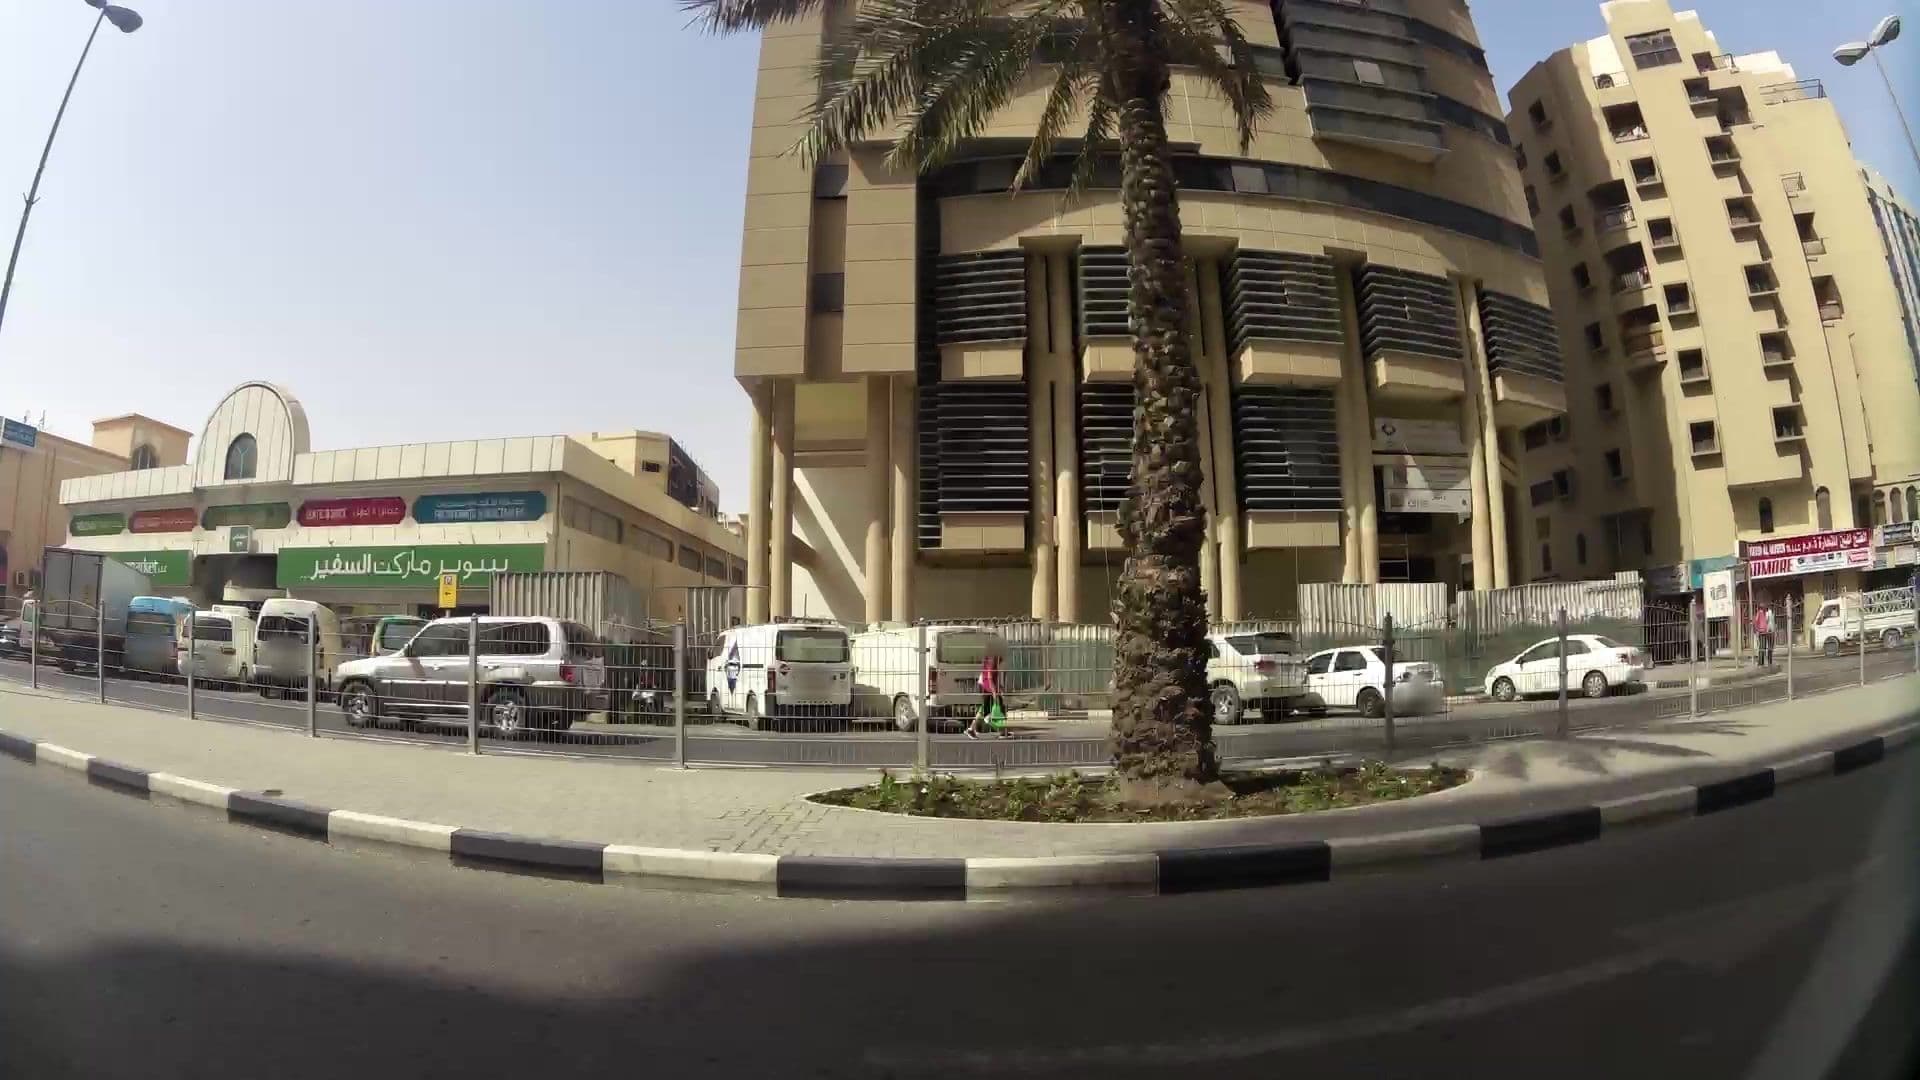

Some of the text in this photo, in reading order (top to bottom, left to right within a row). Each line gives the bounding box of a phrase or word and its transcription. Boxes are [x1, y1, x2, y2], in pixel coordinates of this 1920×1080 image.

[310, 550, 509, 580] سوبر ماركت السفير
